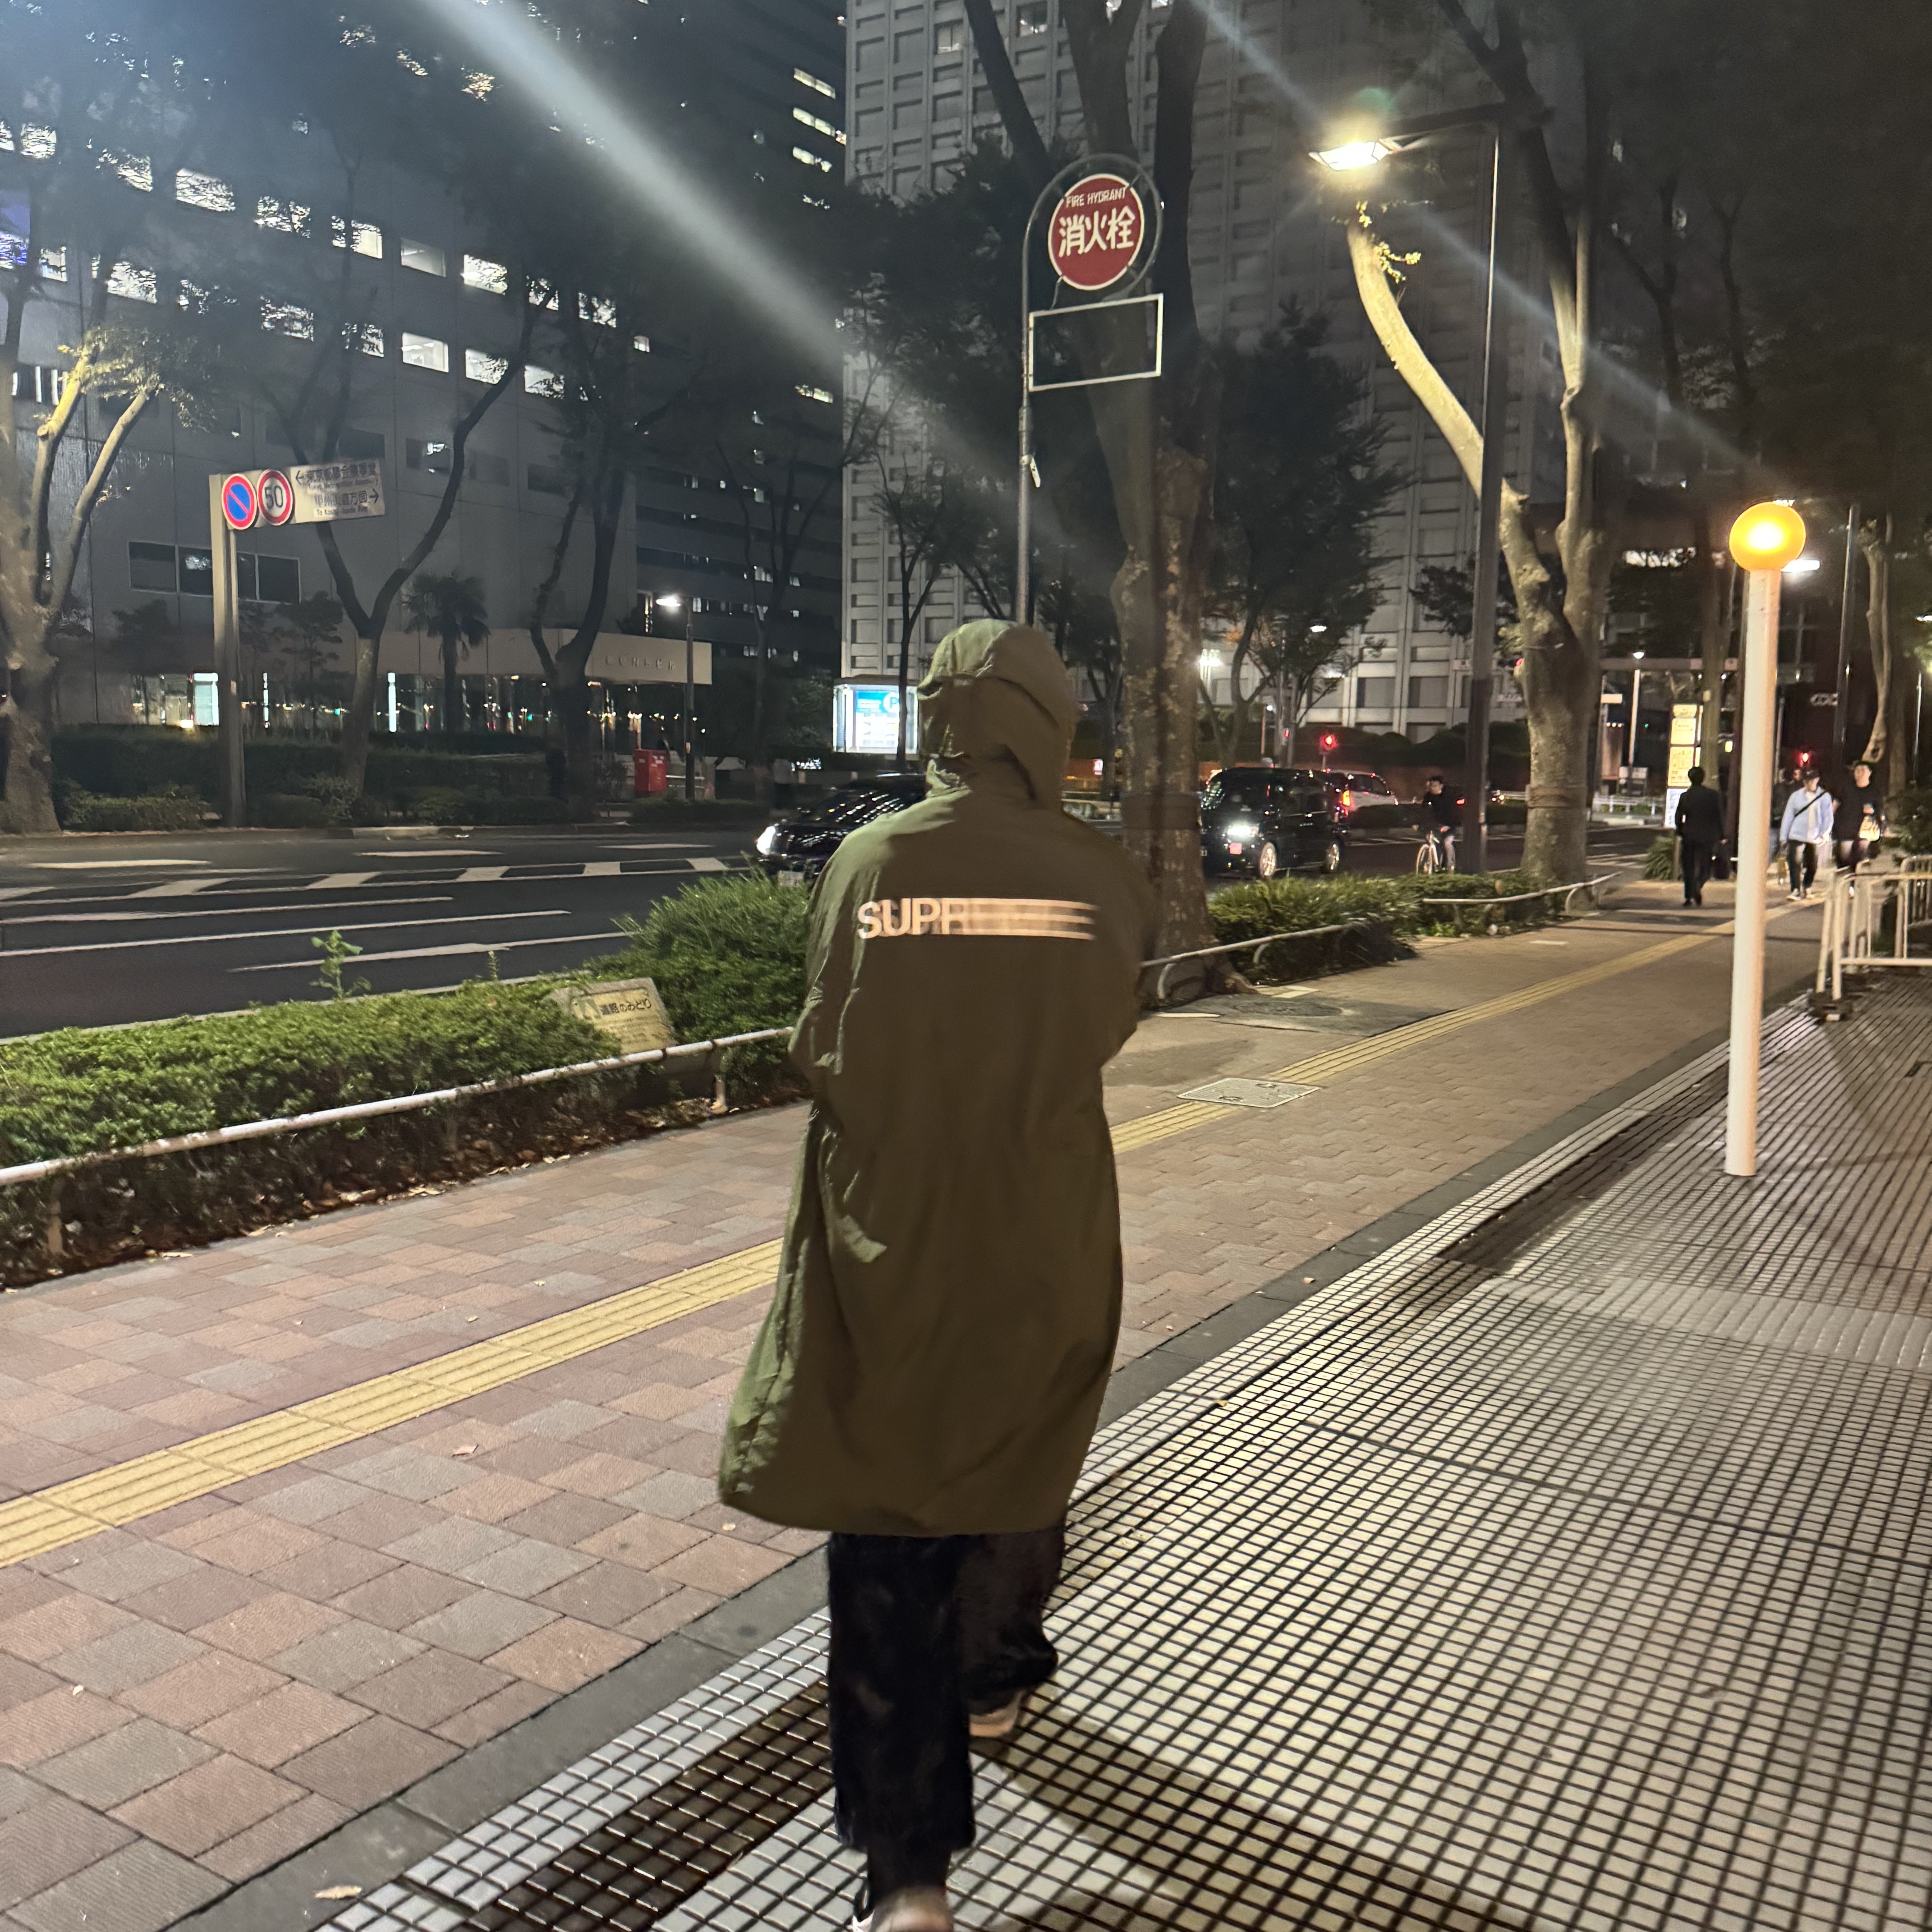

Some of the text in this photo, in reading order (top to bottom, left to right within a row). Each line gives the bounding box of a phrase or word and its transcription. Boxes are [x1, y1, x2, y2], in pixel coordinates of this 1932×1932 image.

[1066, 187, 1127, 207] FIRE HYDRANT
[1058, 205, 1136, 258] 消火栓
[264, 486, 283, 509] 50
